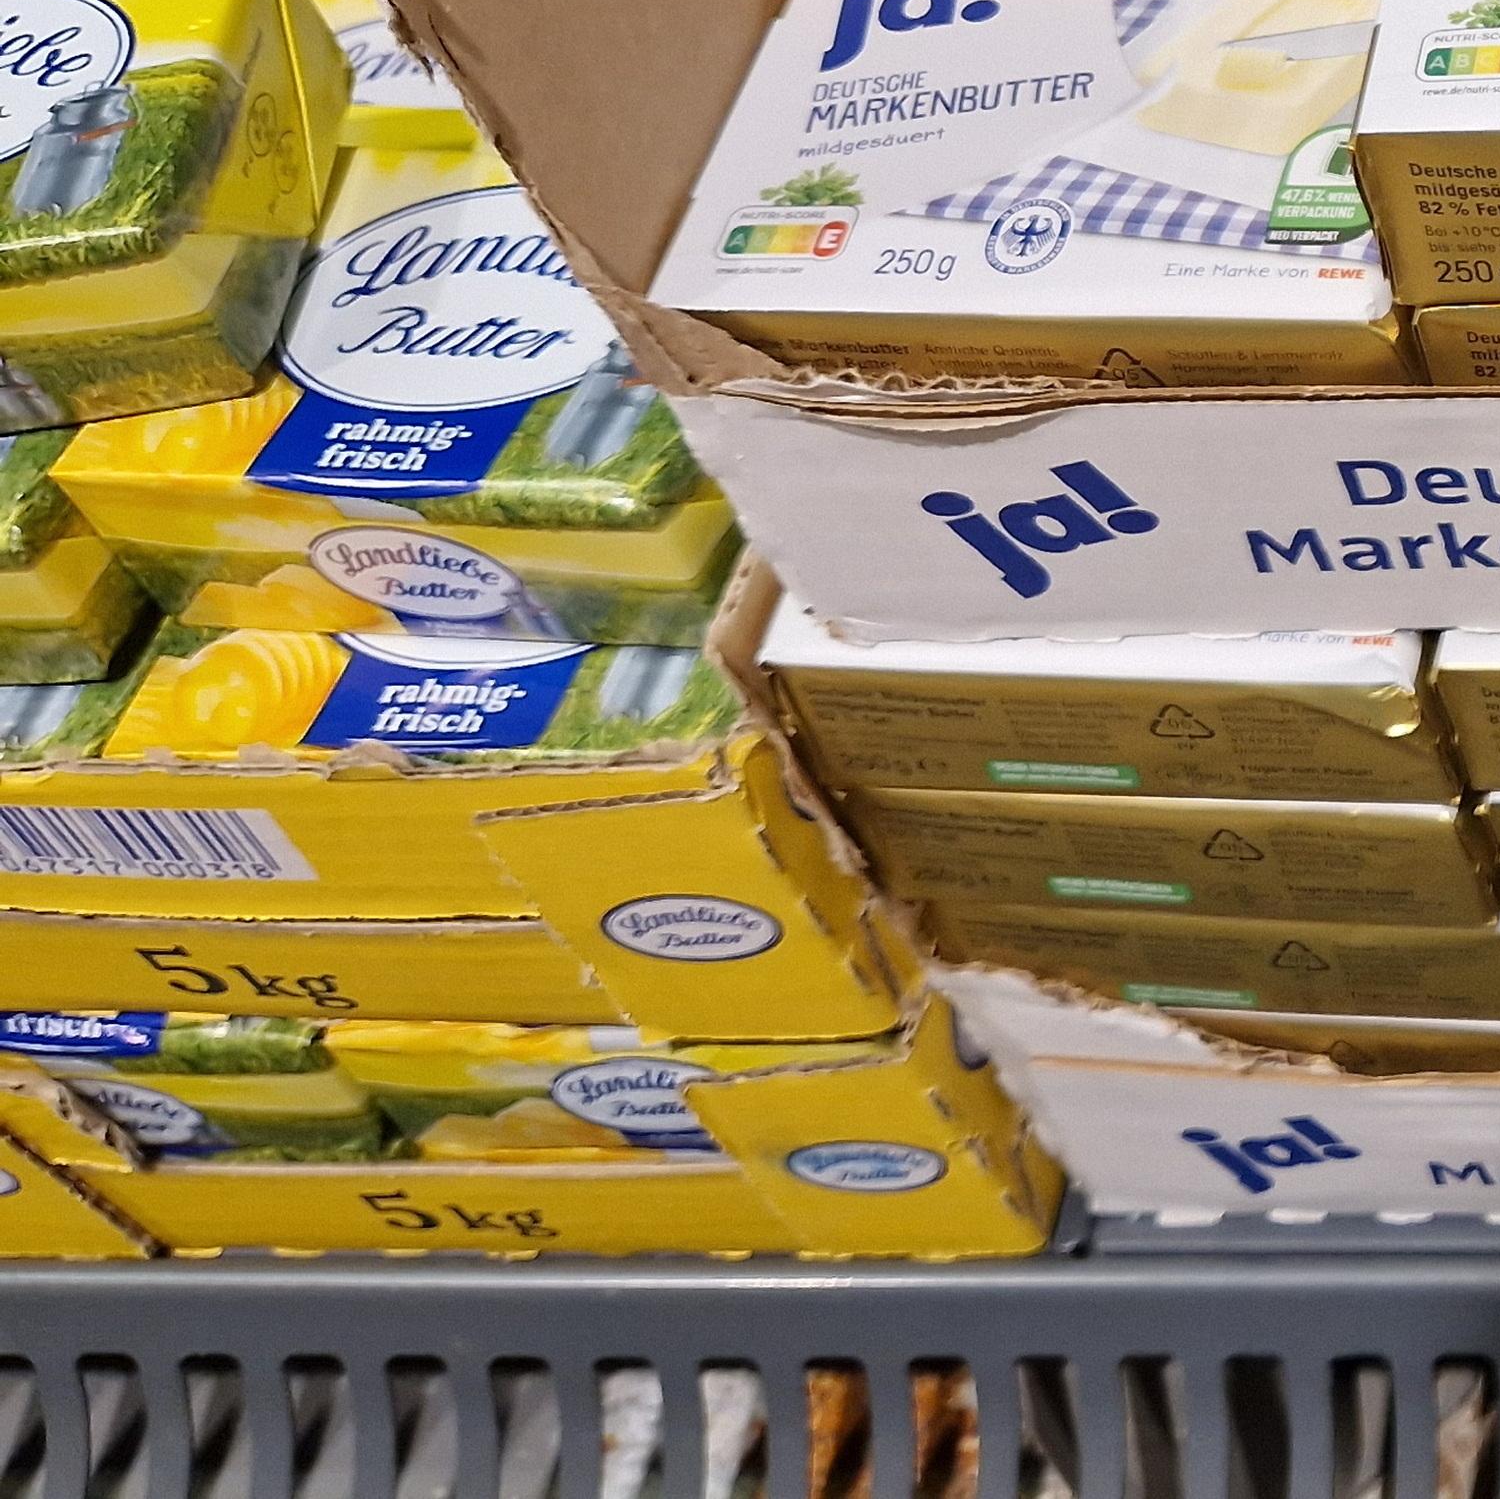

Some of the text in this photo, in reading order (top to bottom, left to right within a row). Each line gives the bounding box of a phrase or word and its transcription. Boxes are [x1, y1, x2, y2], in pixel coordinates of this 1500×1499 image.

[812, 71, 929, 96] DEUTSCHE
[805, 72, 1094, 134] MARKENBUTTER
[1419, 201, 1445, 215] 82
[1449, 202, 1470, 215] %
[337, 306, 576, 359] Butter
[324, 419, 473, 450] rahmig-
[314, 444, 427, 471] frisch
[920, 463, 1159, 598] ja!
[326, 542, 500, 586] Landliebe
[376, 576, 485, 601] Butter
[377, 678, 527, 713] rahmig-
[370, 706, 485, 733] frisch
[619, 905, 762, 938] Landliebe
[134, 944, 359, 1009] 5 kg
[1183, 1116, 1361, 1194] ja!
[359, 1191, 560, 1238] 5 kg
